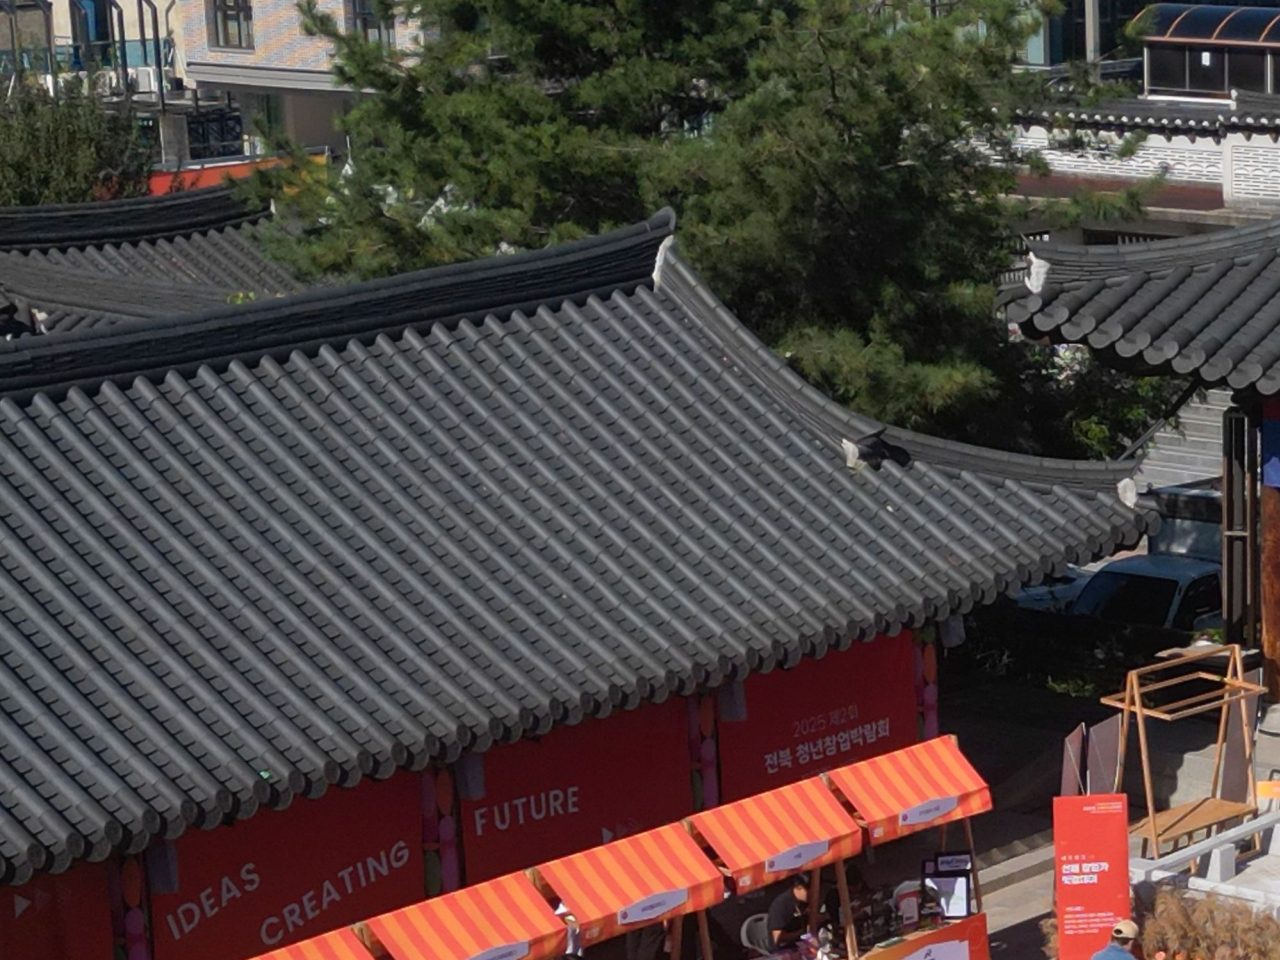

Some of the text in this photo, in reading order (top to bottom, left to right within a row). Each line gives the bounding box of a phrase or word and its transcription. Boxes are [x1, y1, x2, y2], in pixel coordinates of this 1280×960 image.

[764, 717, 890, 774] 전북 청년창업박람회
[793, 714, 826, 738] 2025
[474, 786, 580, 836] FUTURE
[166, 862, 261, 941] IDEAS
[259, 840, 411, 946] CREATING
